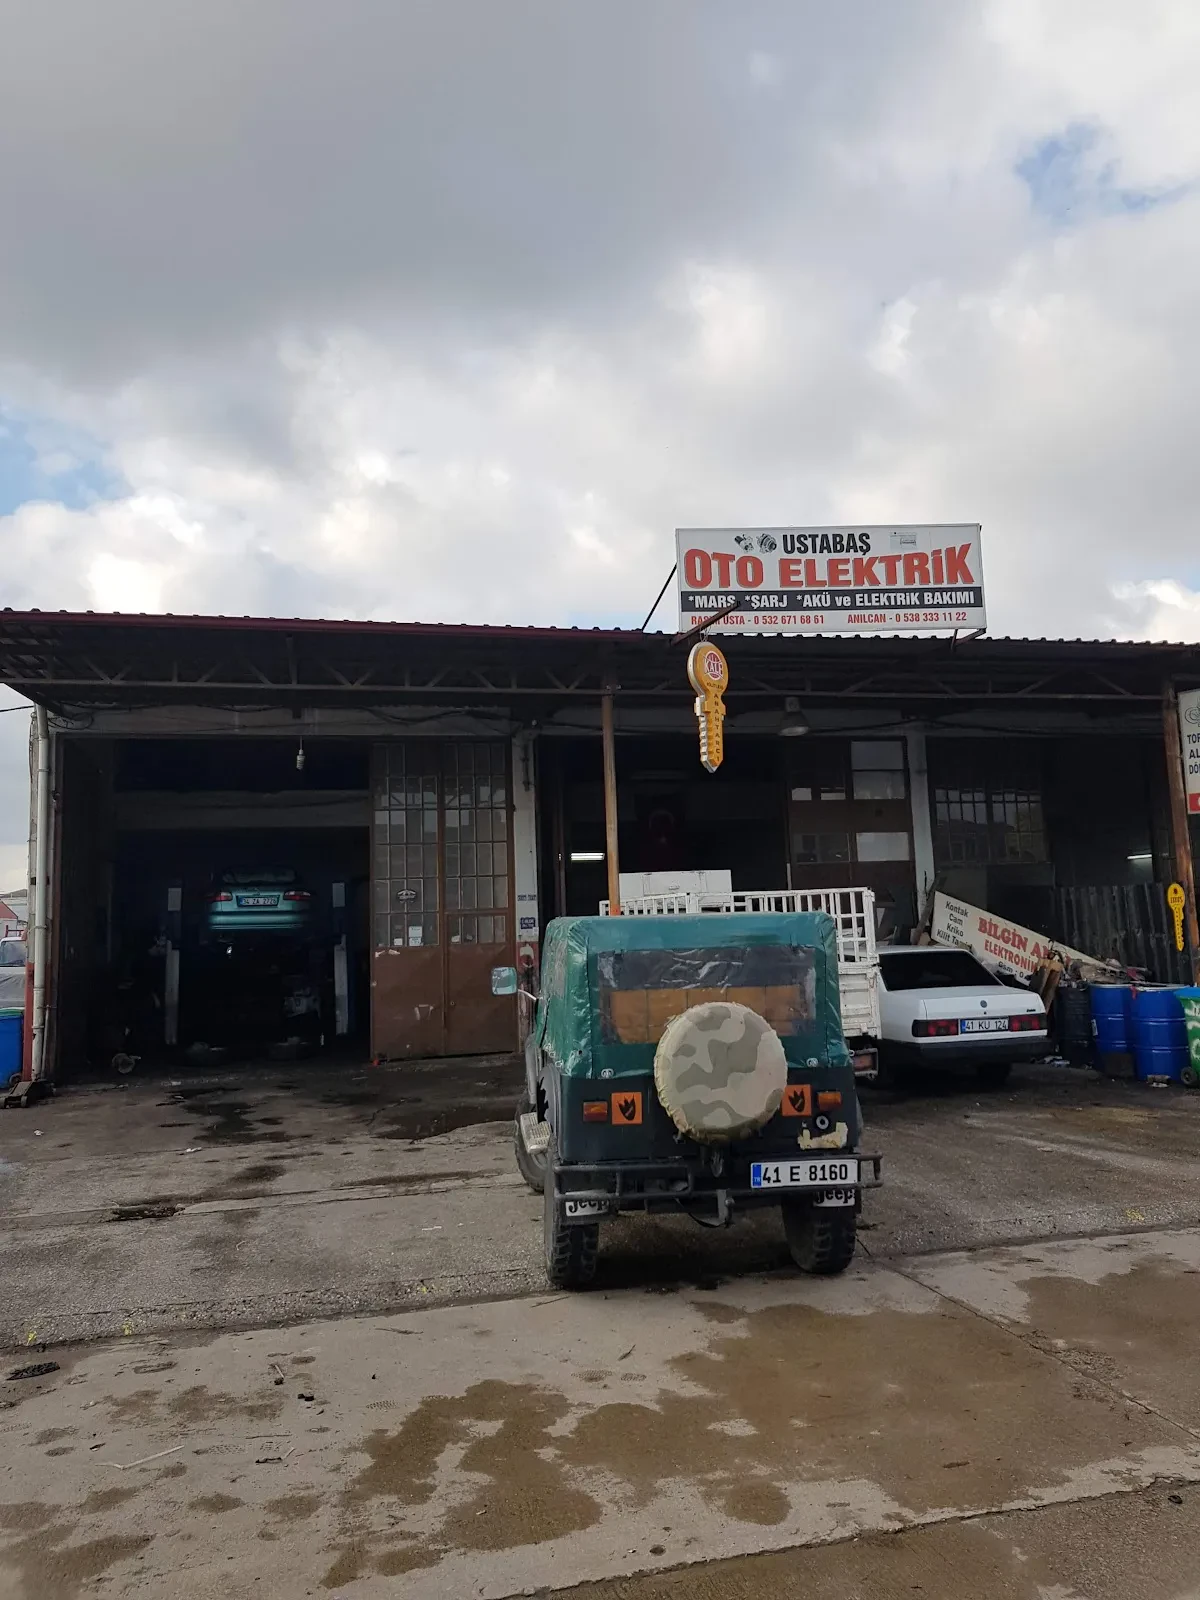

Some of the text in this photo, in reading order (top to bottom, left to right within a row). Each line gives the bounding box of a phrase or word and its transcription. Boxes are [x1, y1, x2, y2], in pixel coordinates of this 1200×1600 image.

[782, 532, 871, 556] USTABAŞ
[684, 548, 764, 589] OTO
[835, 596, 851, 607] ve
[923, 591, 975, 605] BAKIMI
[723, 615, 745, 625] USTA
[754, 615, 760, 625] 0
[762, 615, 778, 625] 532
[781, 615, 797, 625] 671
[800, 614, 811, 624] 68
[814, 614, 824, 624] 61
[847, 613, 886, 624] ANILCAN
[895, 613, 900, 622] 0
[903, 613, 920, 622] 538
[922, 612, 939, 622] 333
[942, 612, 952, 621] 11
[955, 611, 967, 621] 22
[704, 658, 723, 677] KALE
[945, 901, 969, 918] Kontak
[949, 913, 963, 926] Cam
[946, 923, 964, 937] Kriko
[978, 916, 1029, 953] BİLGİN
[965, 1020, 1007, 1030] 41 KU 124
[763, 1167, 781, 1184] 41
[790, 1165, 800, 1182] E
[809, 1164, 848, 1181] 8160
